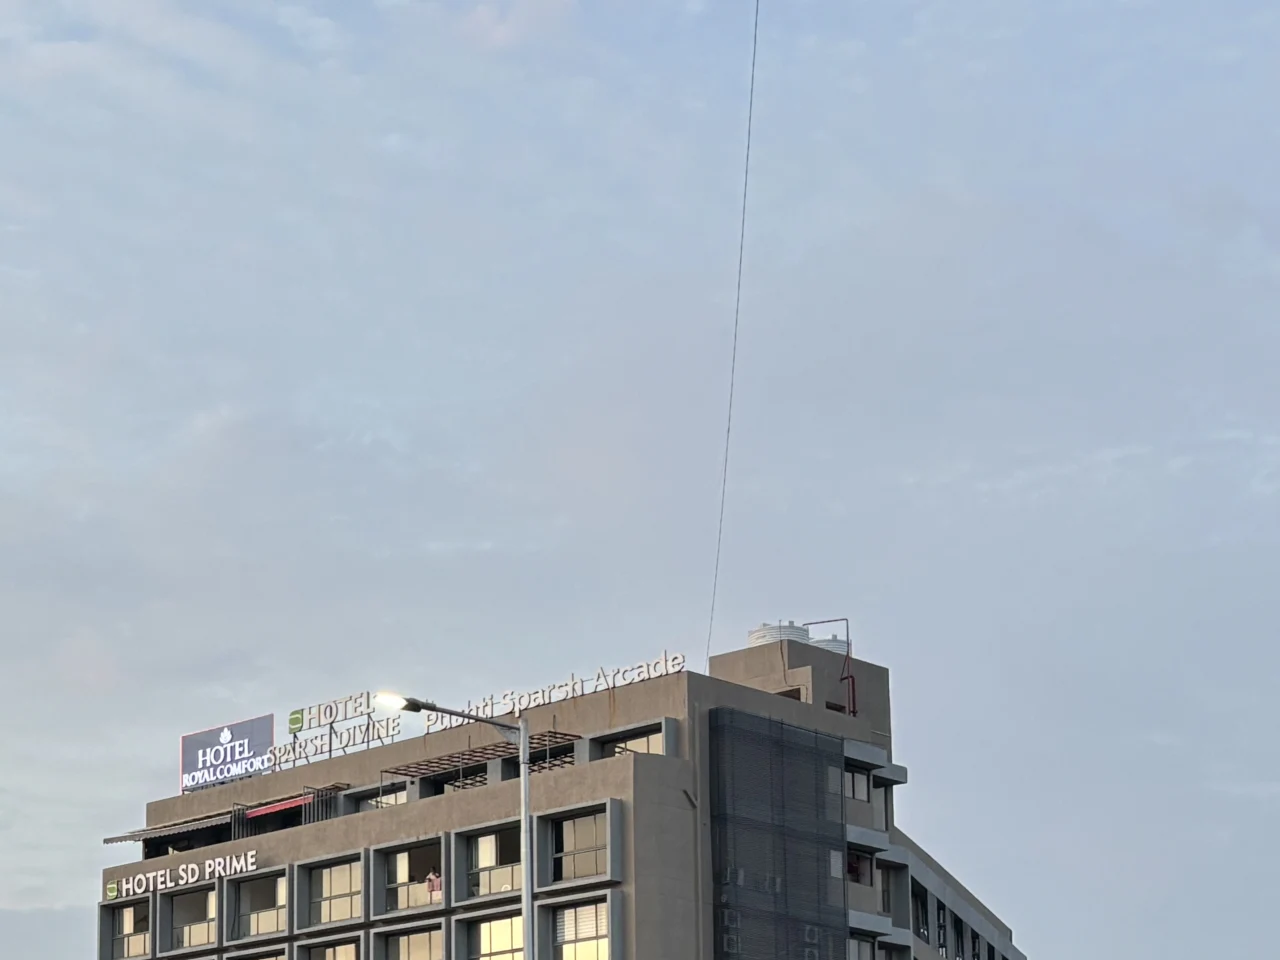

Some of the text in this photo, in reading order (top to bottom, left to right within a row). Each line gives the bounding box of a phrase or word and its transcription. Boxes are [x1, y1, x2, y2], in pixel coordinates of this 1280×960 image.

[499, 673, 584, 717] Sparsh
[593, 650, 686, 692] Arcade
[302, 691, 376, 731] HOTEL
[197, 738, 254, 769] HOTEL
[268, 715, 400, 766] SPARSH DIVINE
[182, 754, 269, 788] ROYAL COMFORT
[122, 850, 257, 898] HOTEL SD PRIME
